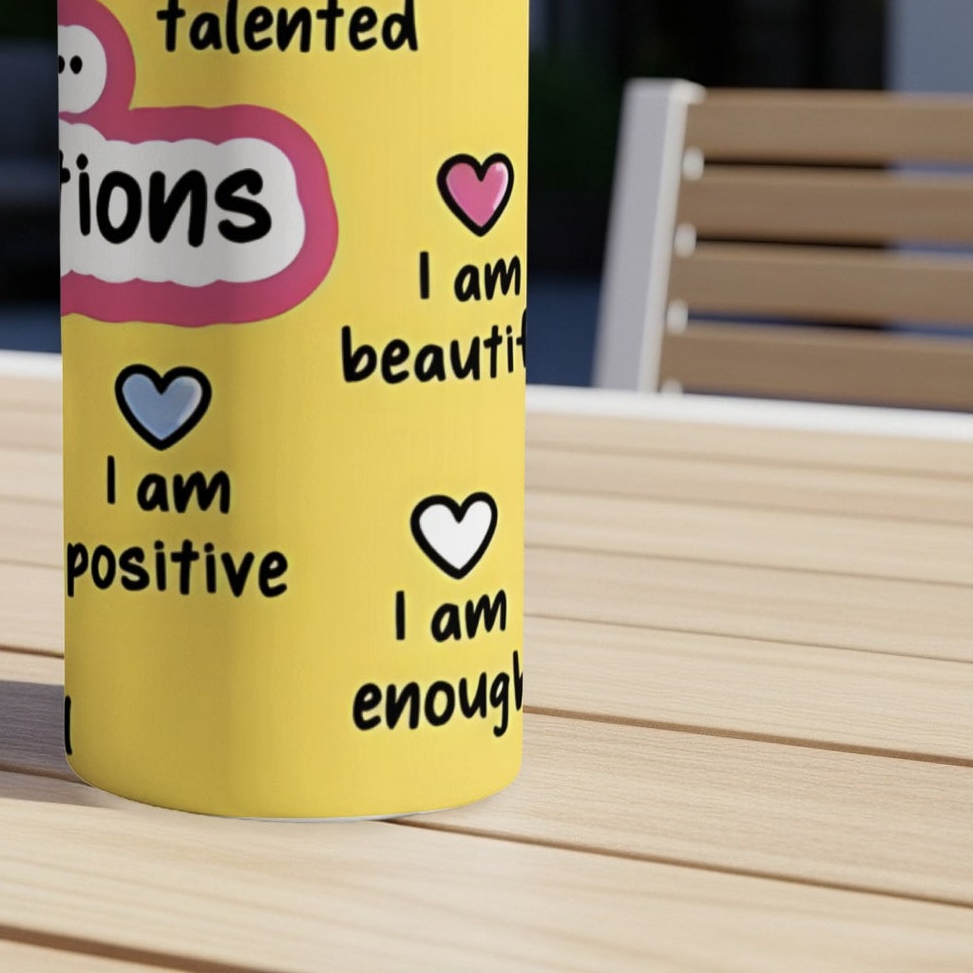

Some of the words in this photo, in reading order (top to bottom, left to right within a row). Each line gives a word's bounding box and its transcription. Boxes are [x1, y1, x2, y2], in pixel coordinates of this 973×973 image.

[420, 251, 430, 300] I
[454, 255, 521, 302] am
[107, 455, 115, 505] I
[137, 470, 230, 515] am
[67, 539, 288, 598] positive
[395, 590, 405, 641] I
[431, 589, 507, 643] am
